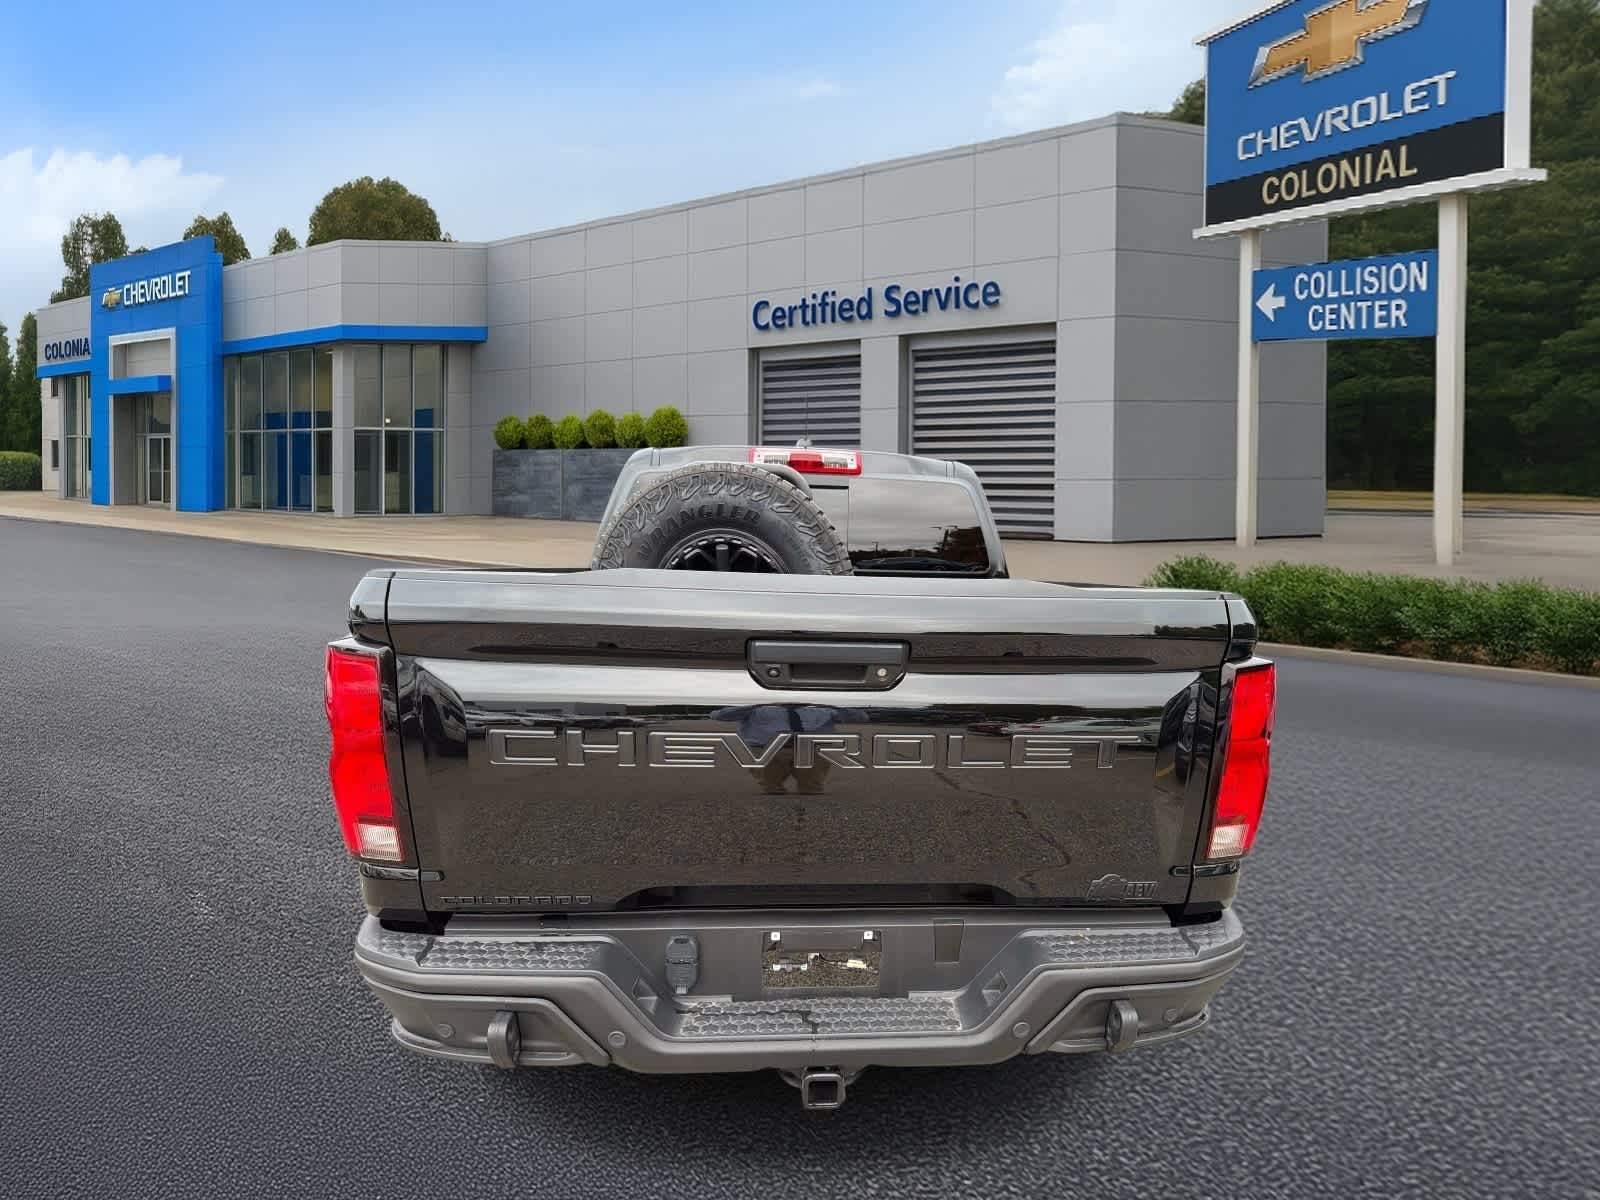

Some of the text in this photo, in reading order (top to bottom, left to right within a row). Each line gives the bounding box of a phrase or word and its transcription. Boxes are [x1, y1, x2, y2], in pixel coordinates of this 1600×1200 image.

[1237, 71, 1457, 160] CHEVROLET
[1261, 145, 1418, 205] COLONIAL
[123, 271, 191, 306] CHEVROLET
[1294, 261, 1428, 301] COLLISION
[752, 276, 1001, 331] Certified Service
[1308, 300, 1409, 331] CENTER
[488, 729, 1143, 769] CHEVROLET
[439, 895, 592, 904] COLORADO
